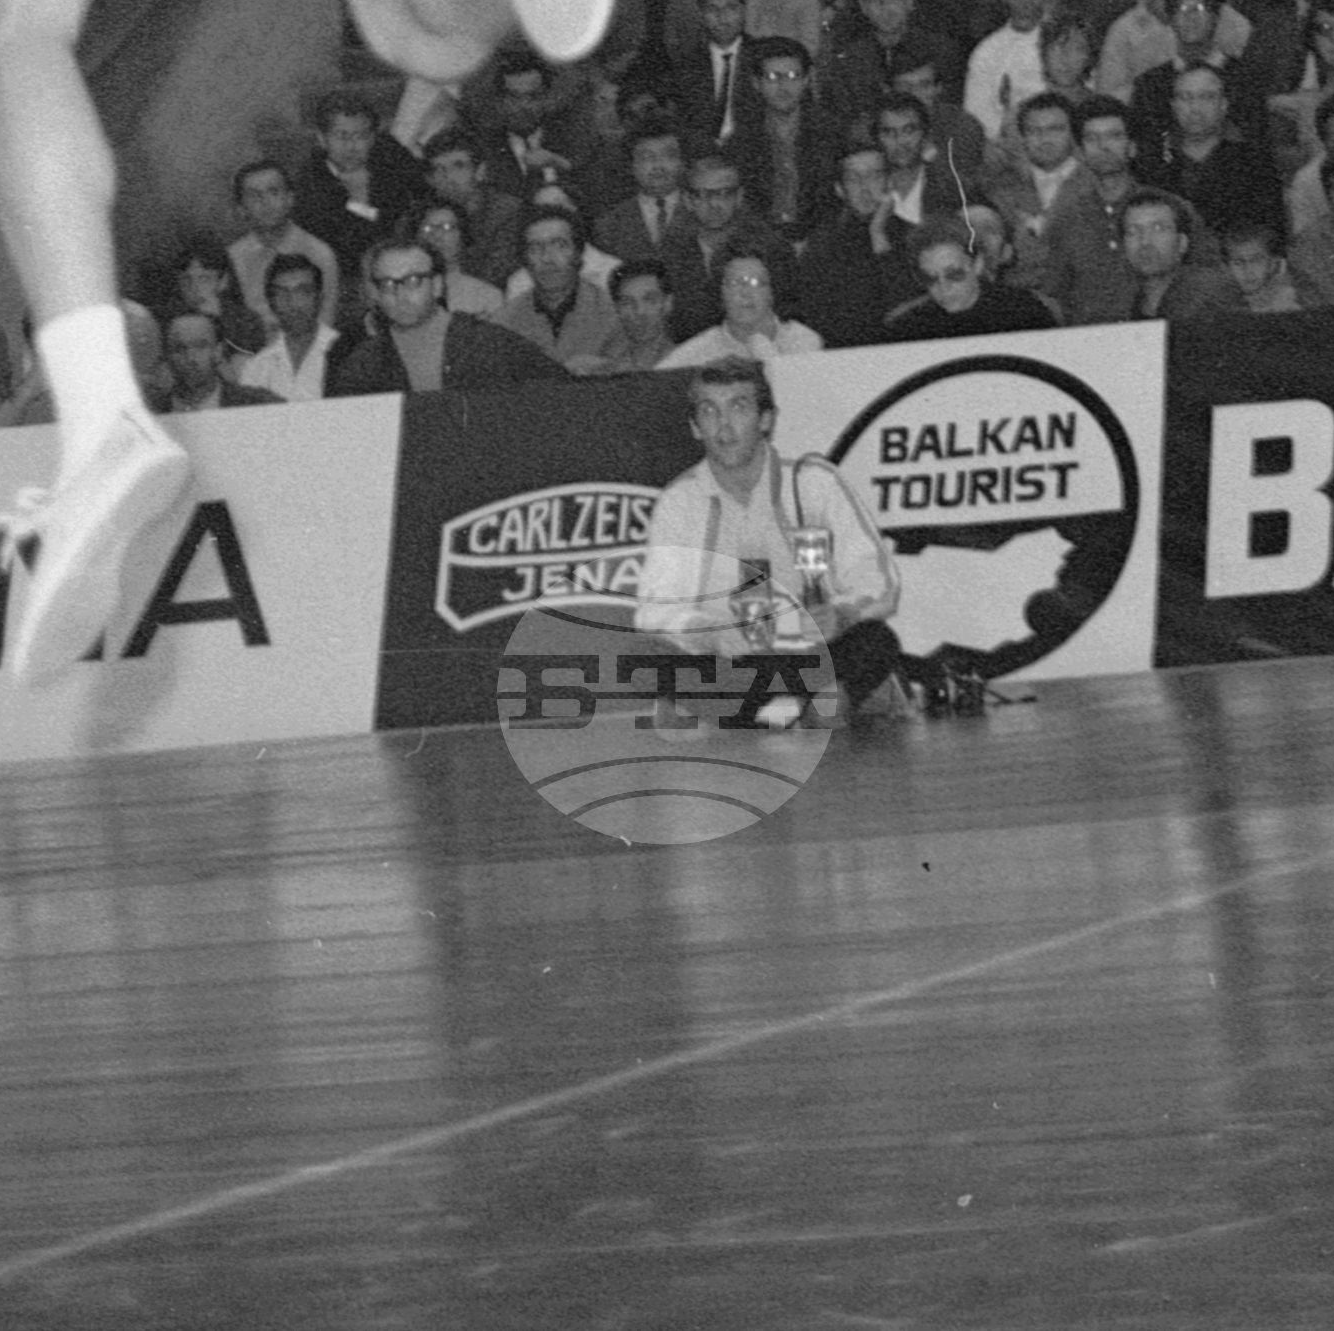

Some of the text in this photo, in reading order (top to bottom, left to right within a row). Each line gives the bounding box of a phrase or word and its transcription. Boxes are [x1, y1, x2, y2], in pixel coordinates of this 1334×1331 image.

[880, 411, 1077, 464] BALKAN
[870, 461, 1080, 512] TOURIST
[501, 556, 643, 602] JENA
